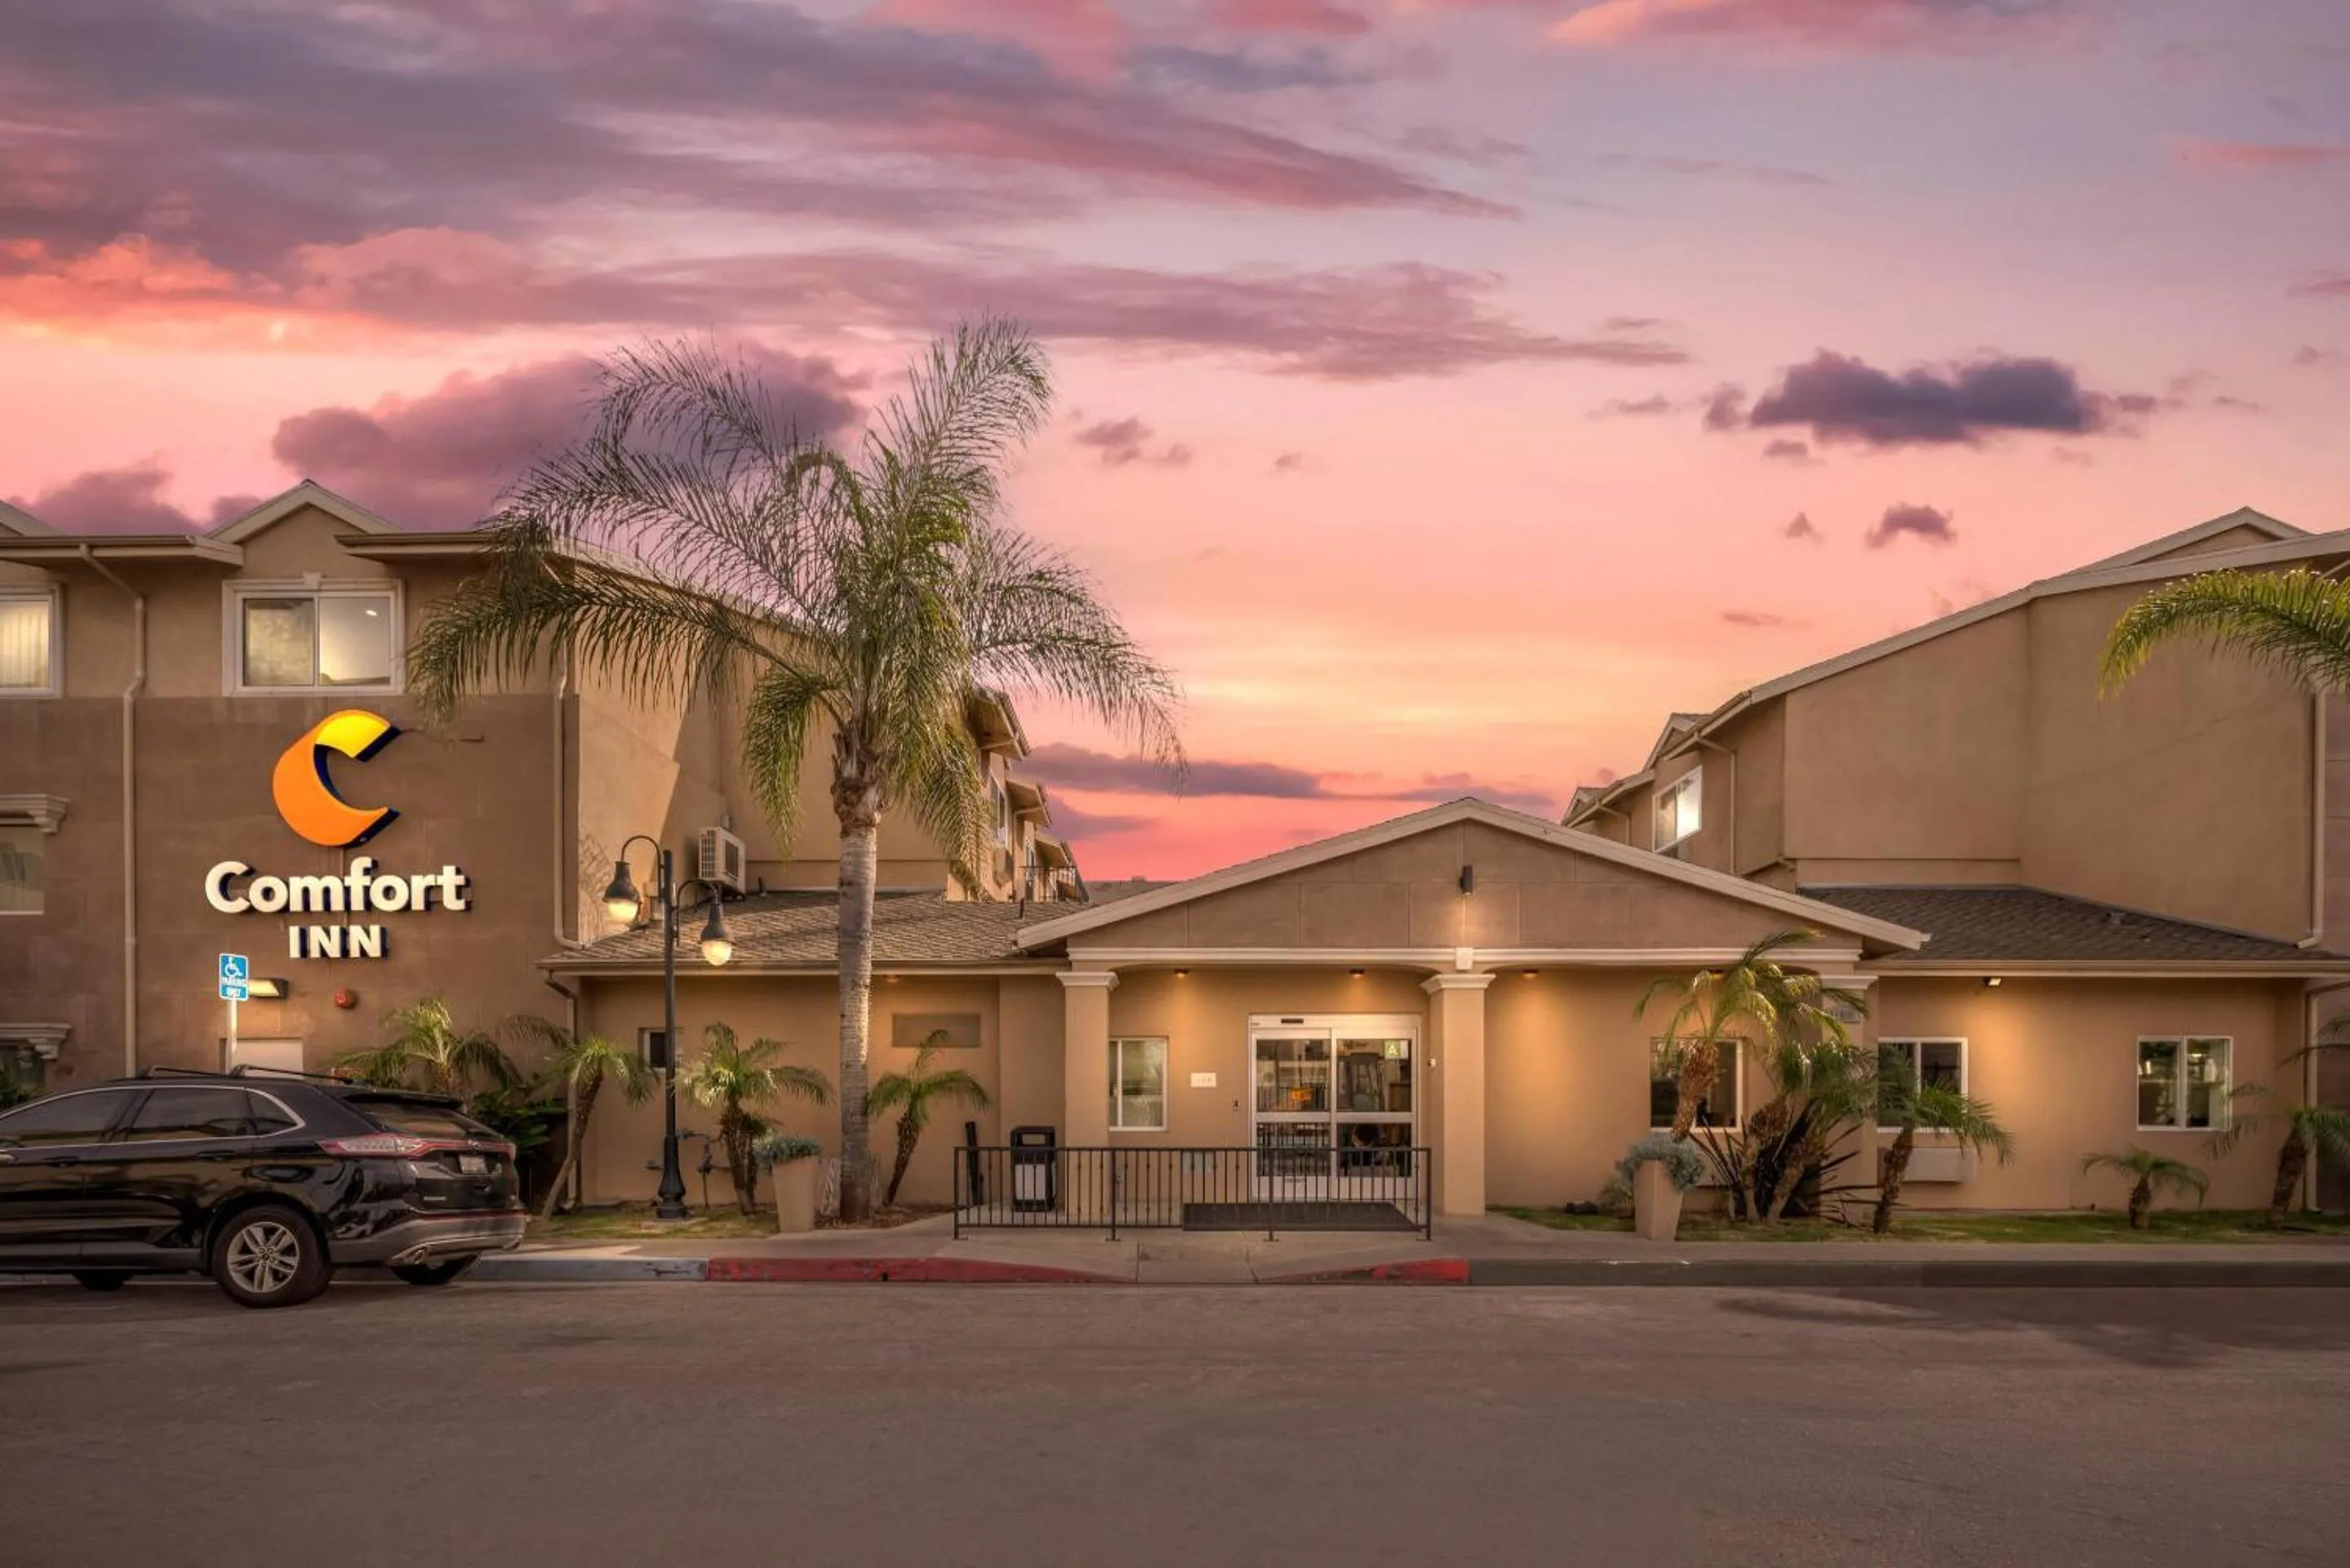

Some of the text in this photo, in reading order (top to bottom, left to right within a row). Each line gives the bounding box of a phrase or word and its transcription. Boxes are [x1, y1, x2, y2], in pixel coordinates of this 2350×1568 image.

[205, 856, 468, 913] Comfort
[289, 924, 384, 958] INN
[1387, 1043, 1399, 1055] A
